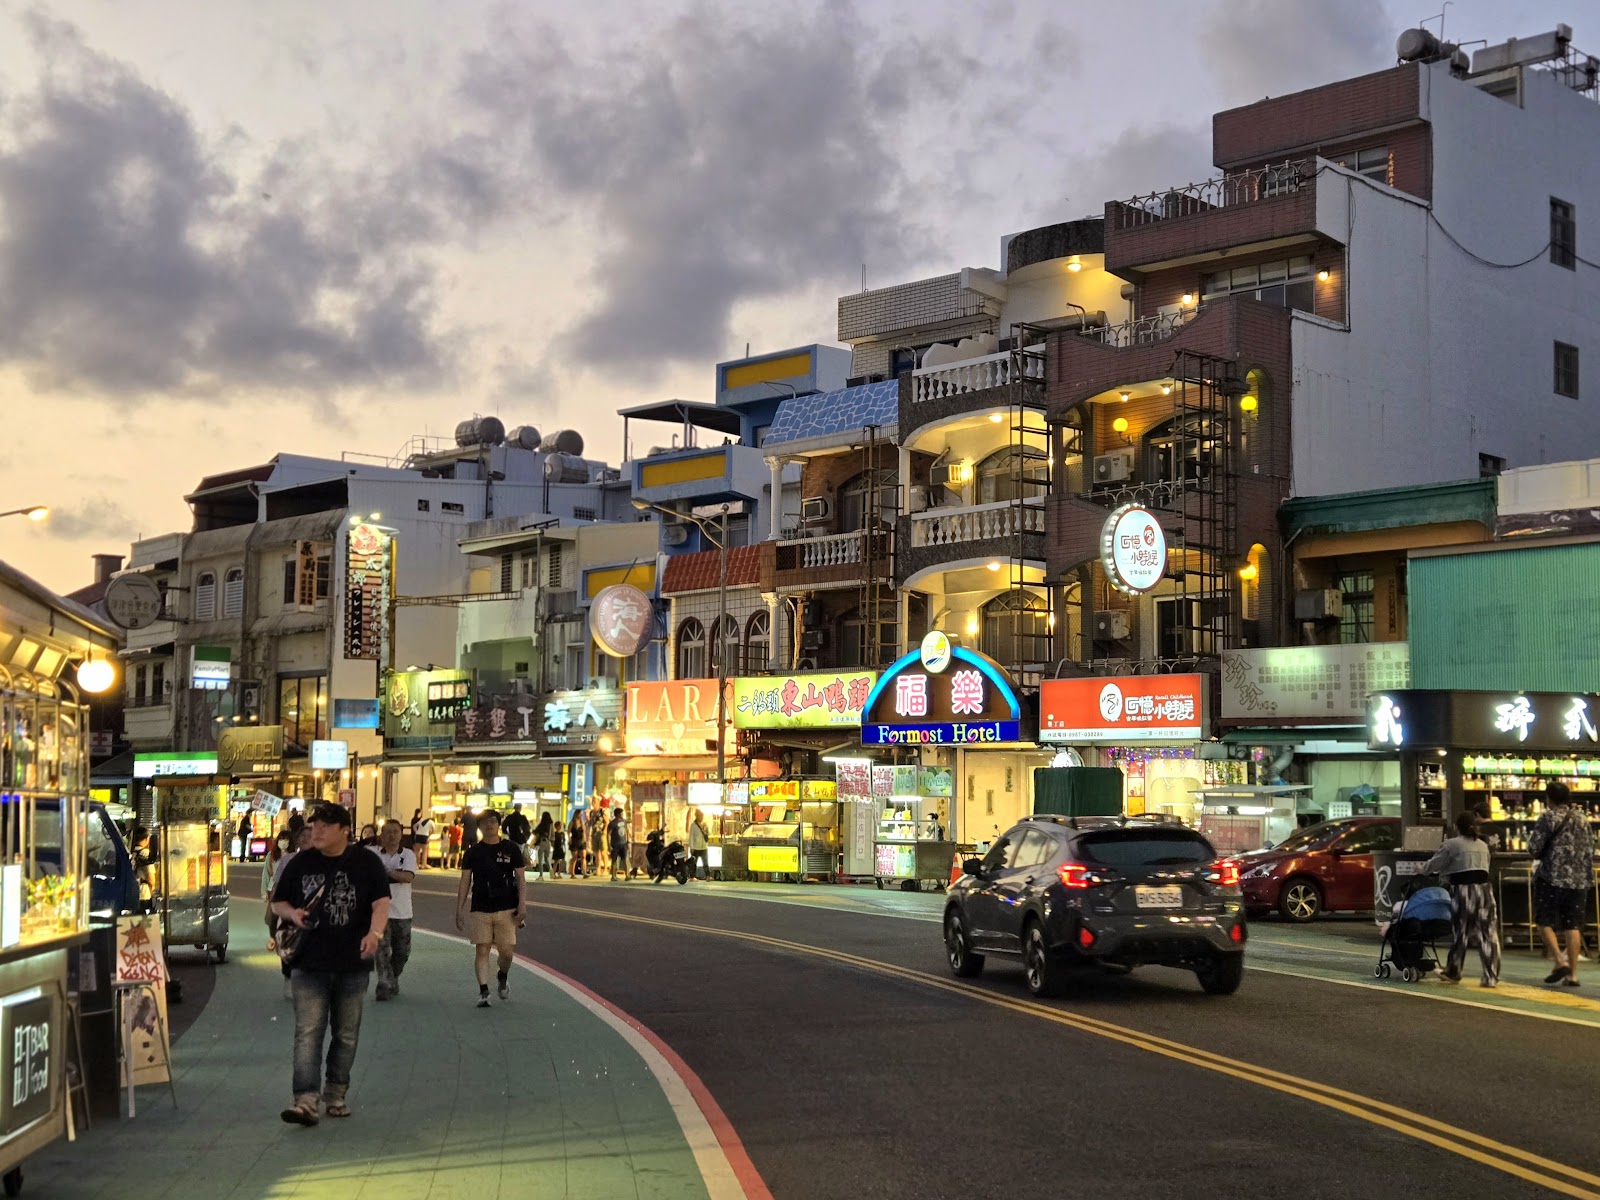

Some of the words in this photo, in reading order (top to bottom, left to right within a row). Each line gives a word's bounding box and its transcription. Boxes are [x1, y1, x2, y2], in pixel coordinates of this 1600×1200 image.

[195, 665, 229, 674] FamilyMart
[878, 725, 944, 744] Formost
[951, 722, 1001, 742] Hotel
[237, 740, 281, 760] MODEL
[31, 1022, 49, 1057] BAR
